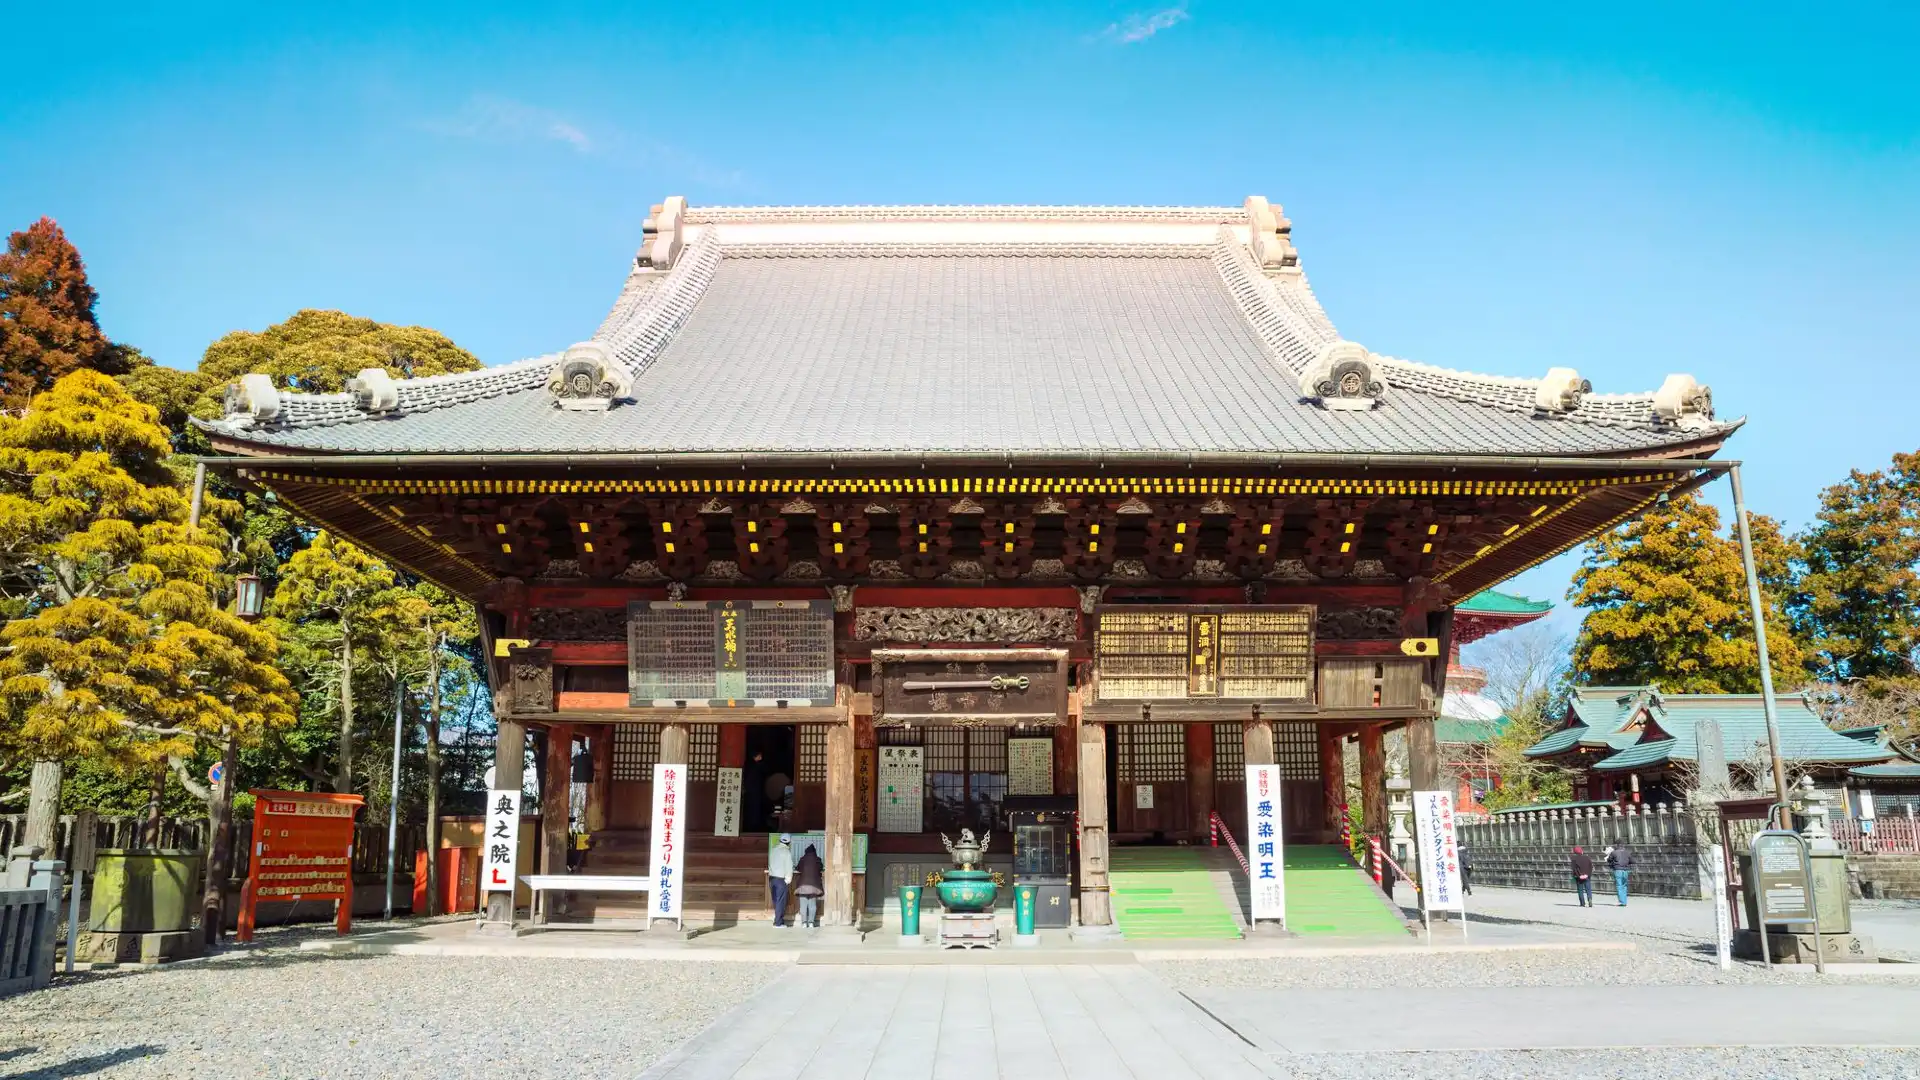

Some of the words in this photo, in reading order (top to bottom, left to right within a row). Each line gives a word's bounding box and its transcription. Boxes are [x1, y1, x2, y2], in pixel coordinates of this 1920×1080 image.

[490, 794, 515, 865] 奥之院
[1256, 800, 1276, 880] 愛染明王
